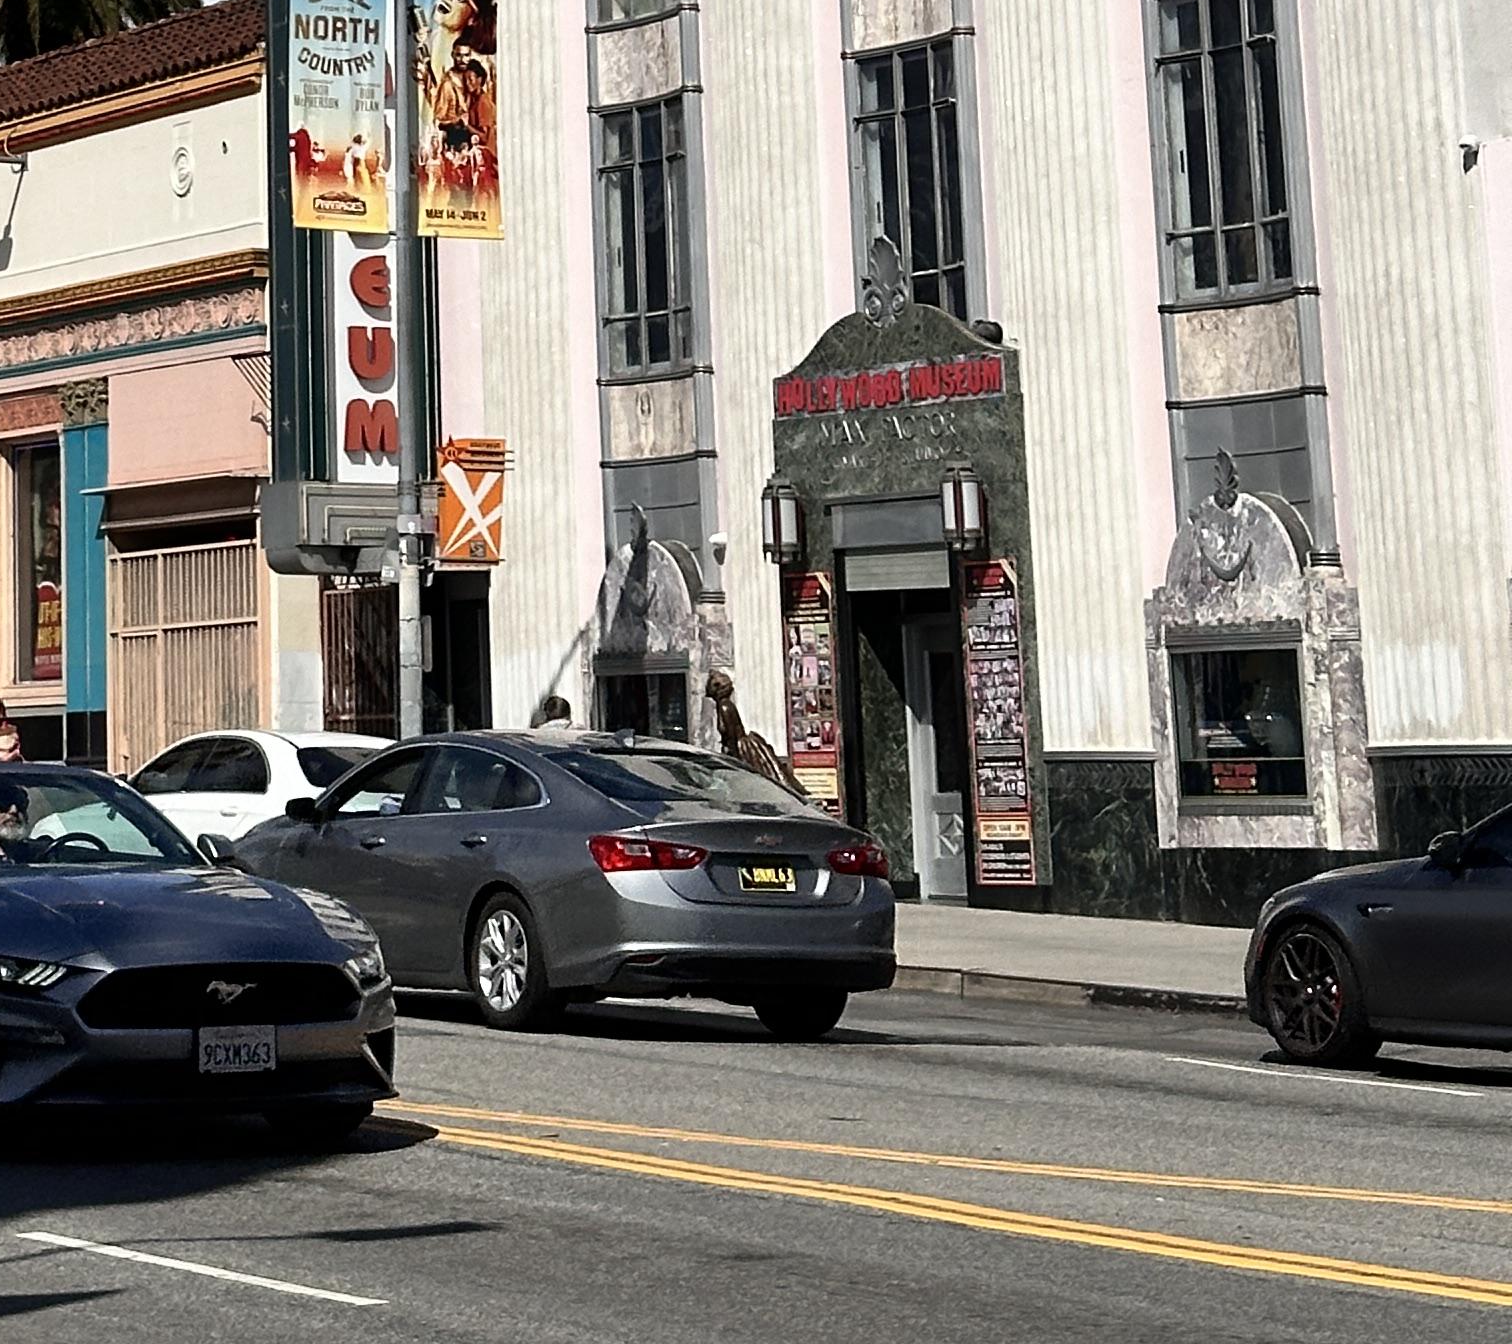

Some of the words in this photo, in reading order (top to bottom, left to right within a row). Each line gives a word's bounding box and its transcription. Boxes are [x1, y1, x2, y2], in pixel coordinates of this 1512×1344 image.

[294, 13, 380, 45] NORTH
[297, 47, 375, 77] COUNTRY
[777, 369, 903, 417] HOLLYWOOD
[909, 355, 1002, 400] MUSEUM
